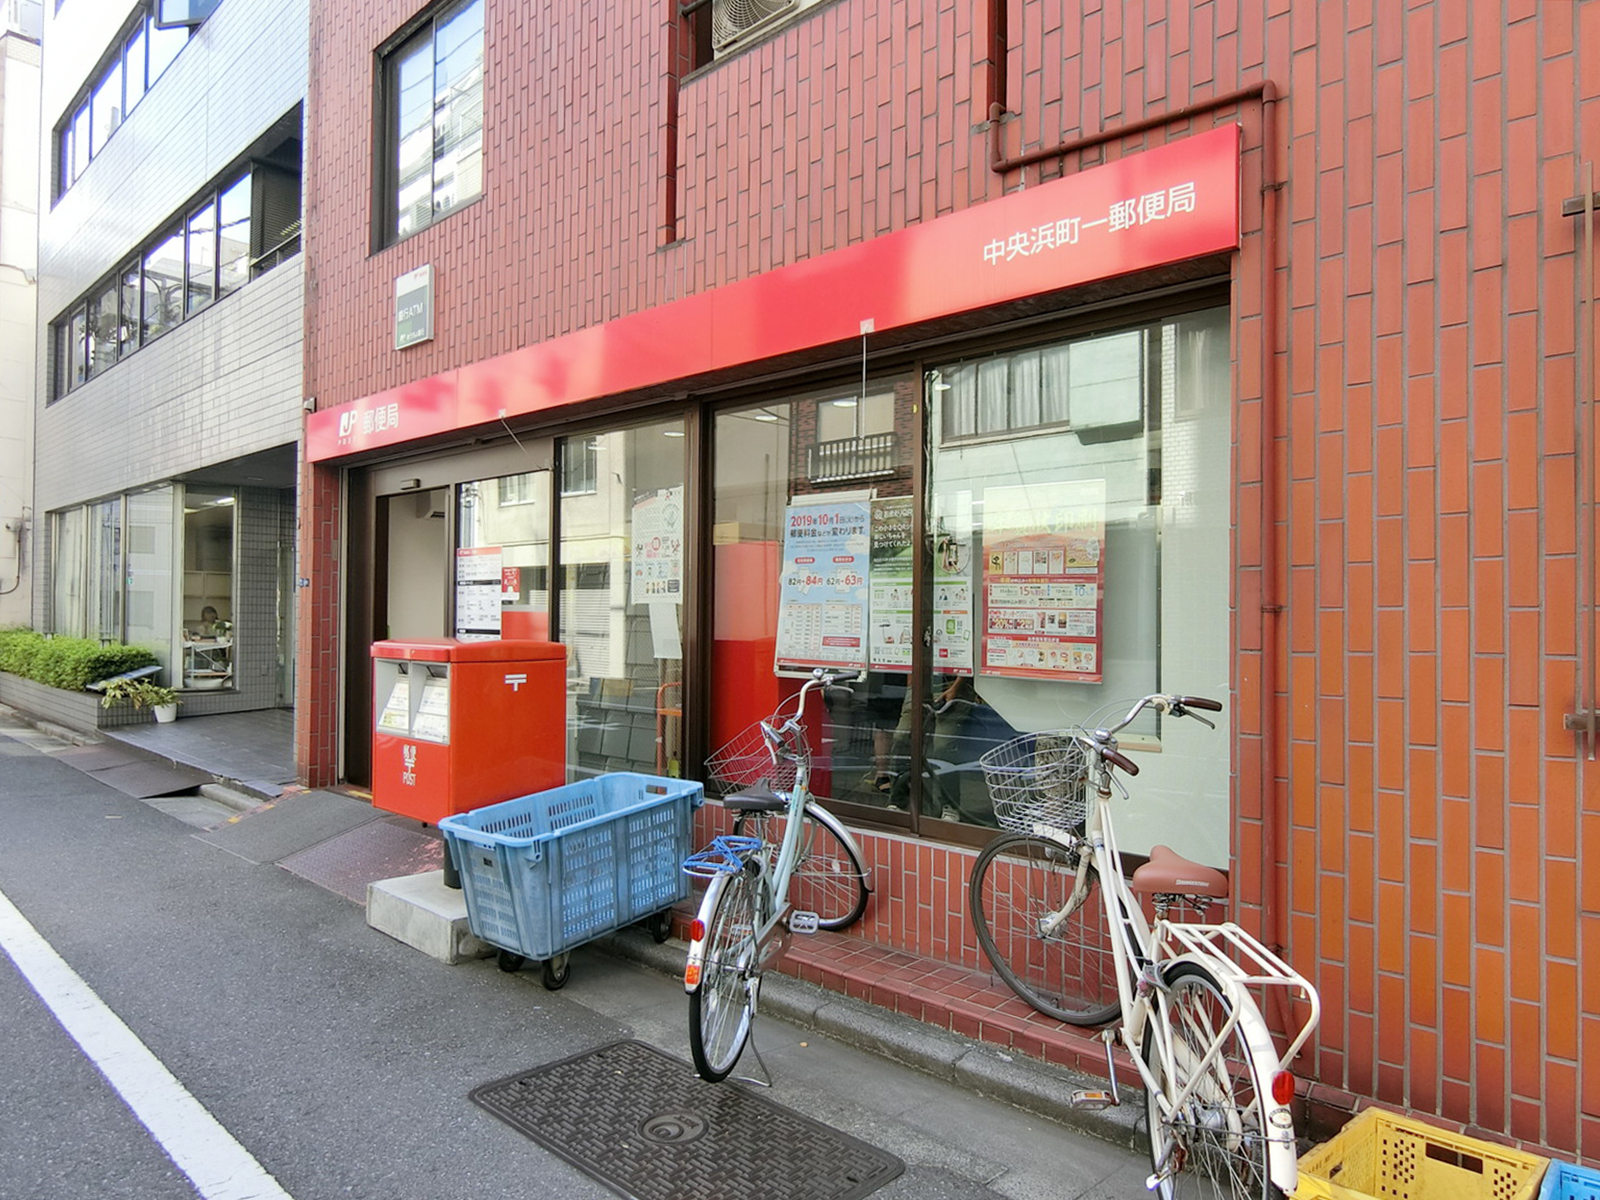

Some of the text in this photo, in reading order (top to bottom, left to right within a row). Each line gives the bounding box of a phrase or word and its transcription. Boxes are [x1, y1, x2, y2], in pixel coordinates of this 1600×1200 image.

[983, 182, 1197, 266] 中央浜町一郵便局
[363, 402, 399, 435] 郵便局
[403, 771, 417, 786] POST
